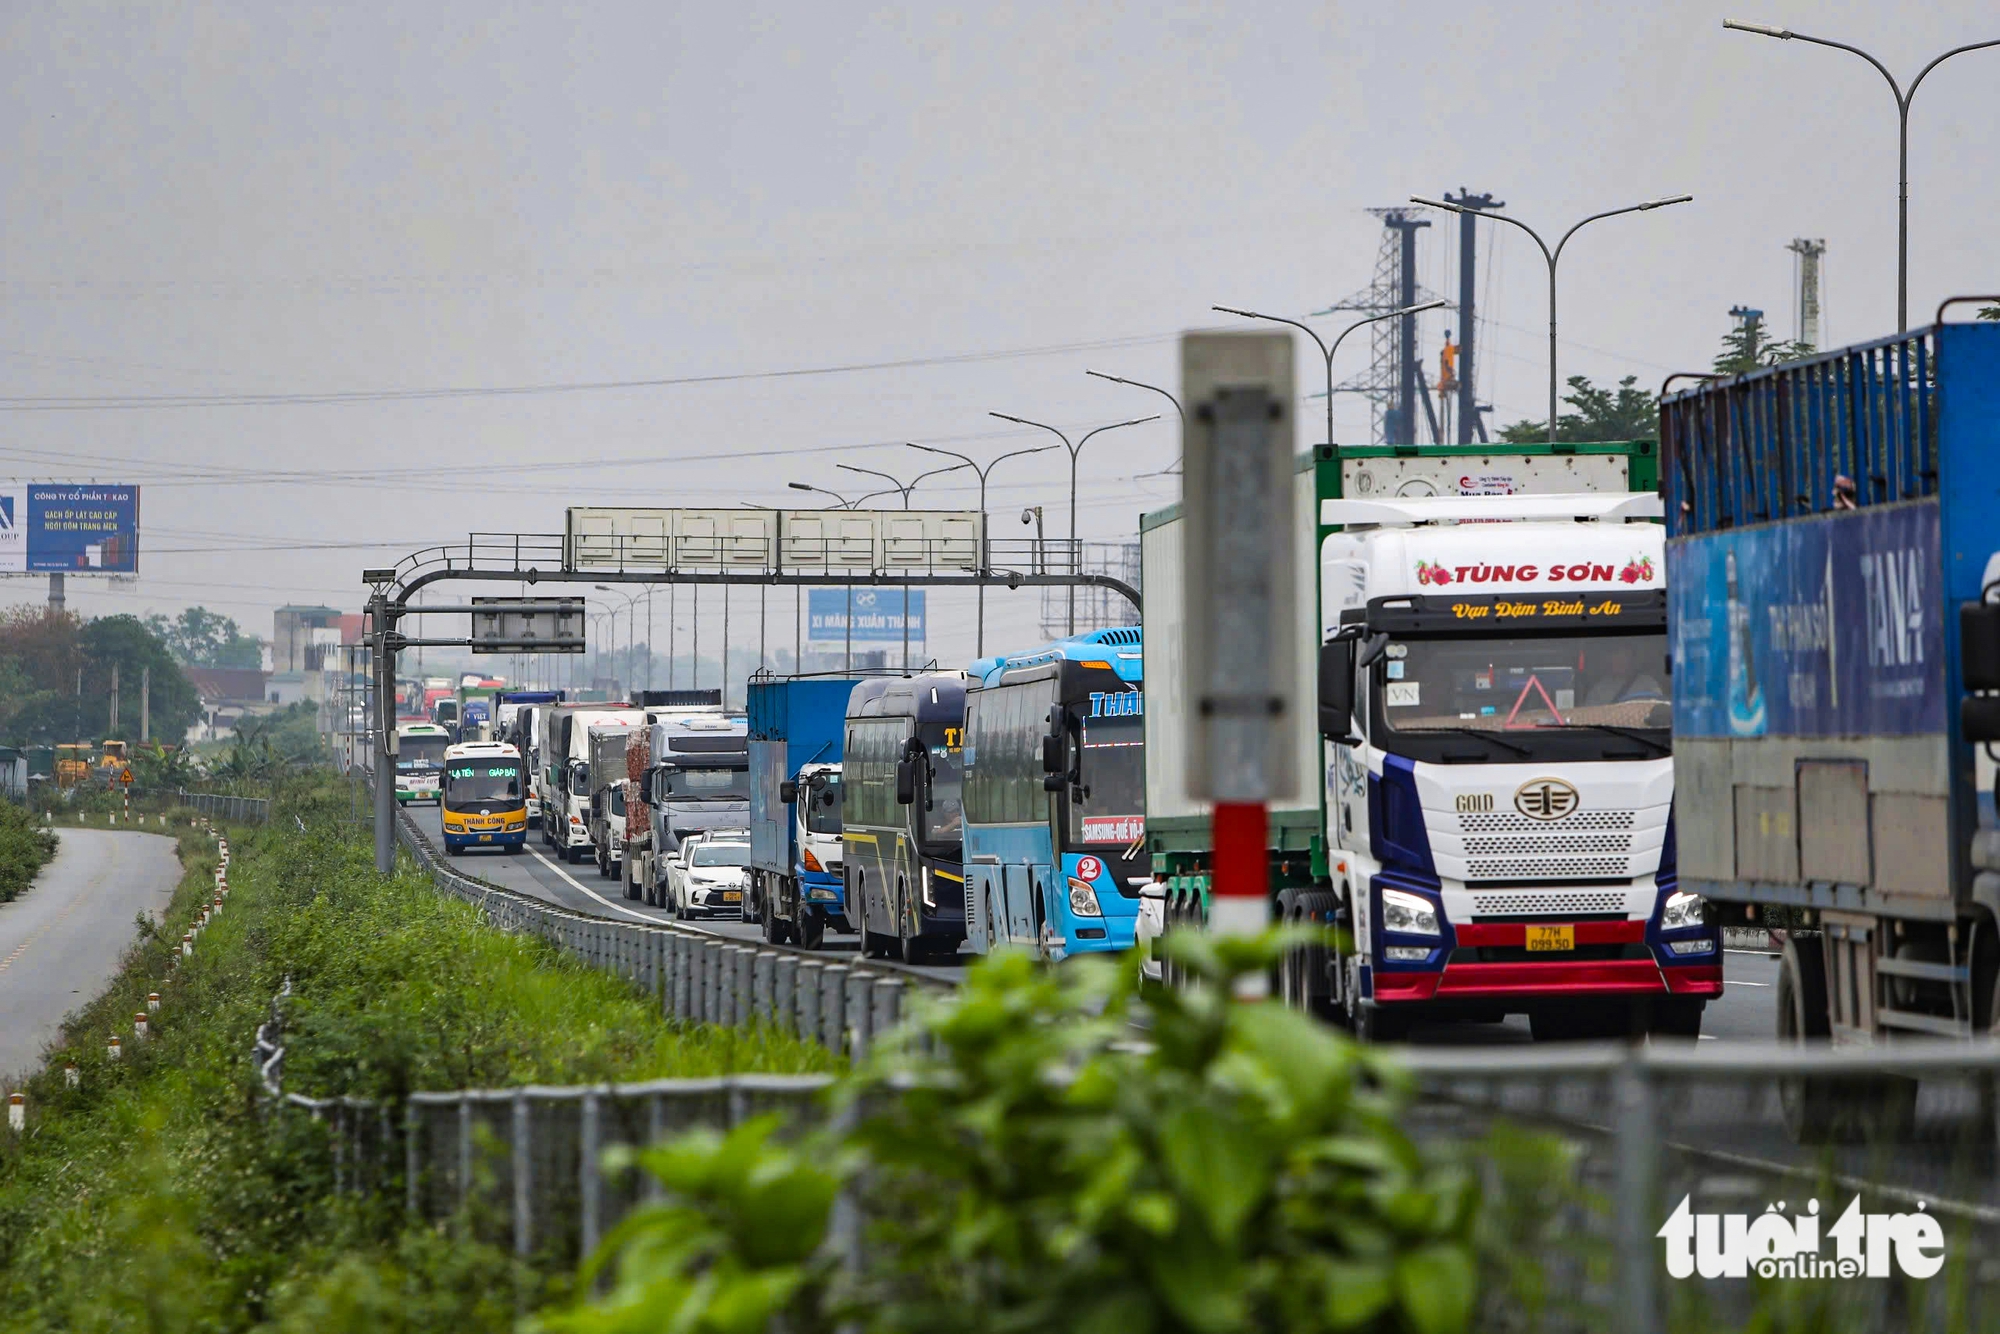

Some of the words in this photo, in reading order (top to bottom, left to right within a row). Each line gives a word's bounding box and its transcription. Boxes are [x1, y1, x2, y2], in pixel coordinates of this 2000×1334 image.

[1454, 561, 1540, 584] TÙNG
[1547, 560, 1615, 582] SƠN
[1451, 601, 1491, 620] Vạn
[1494, 600, 1537, 618] Dặm
[1542, 599, 1586, 617] Bình
[1588, 599, 1623, 616] An
[1089, 682, 1143, 718] THÀ
[1456, 793, 1494, 813] GOLD
[1080, 860, 1097, 880] 2
[1539, 926, 1561, 938] 77H
[1531, 938, 1570, 950] 099.50
